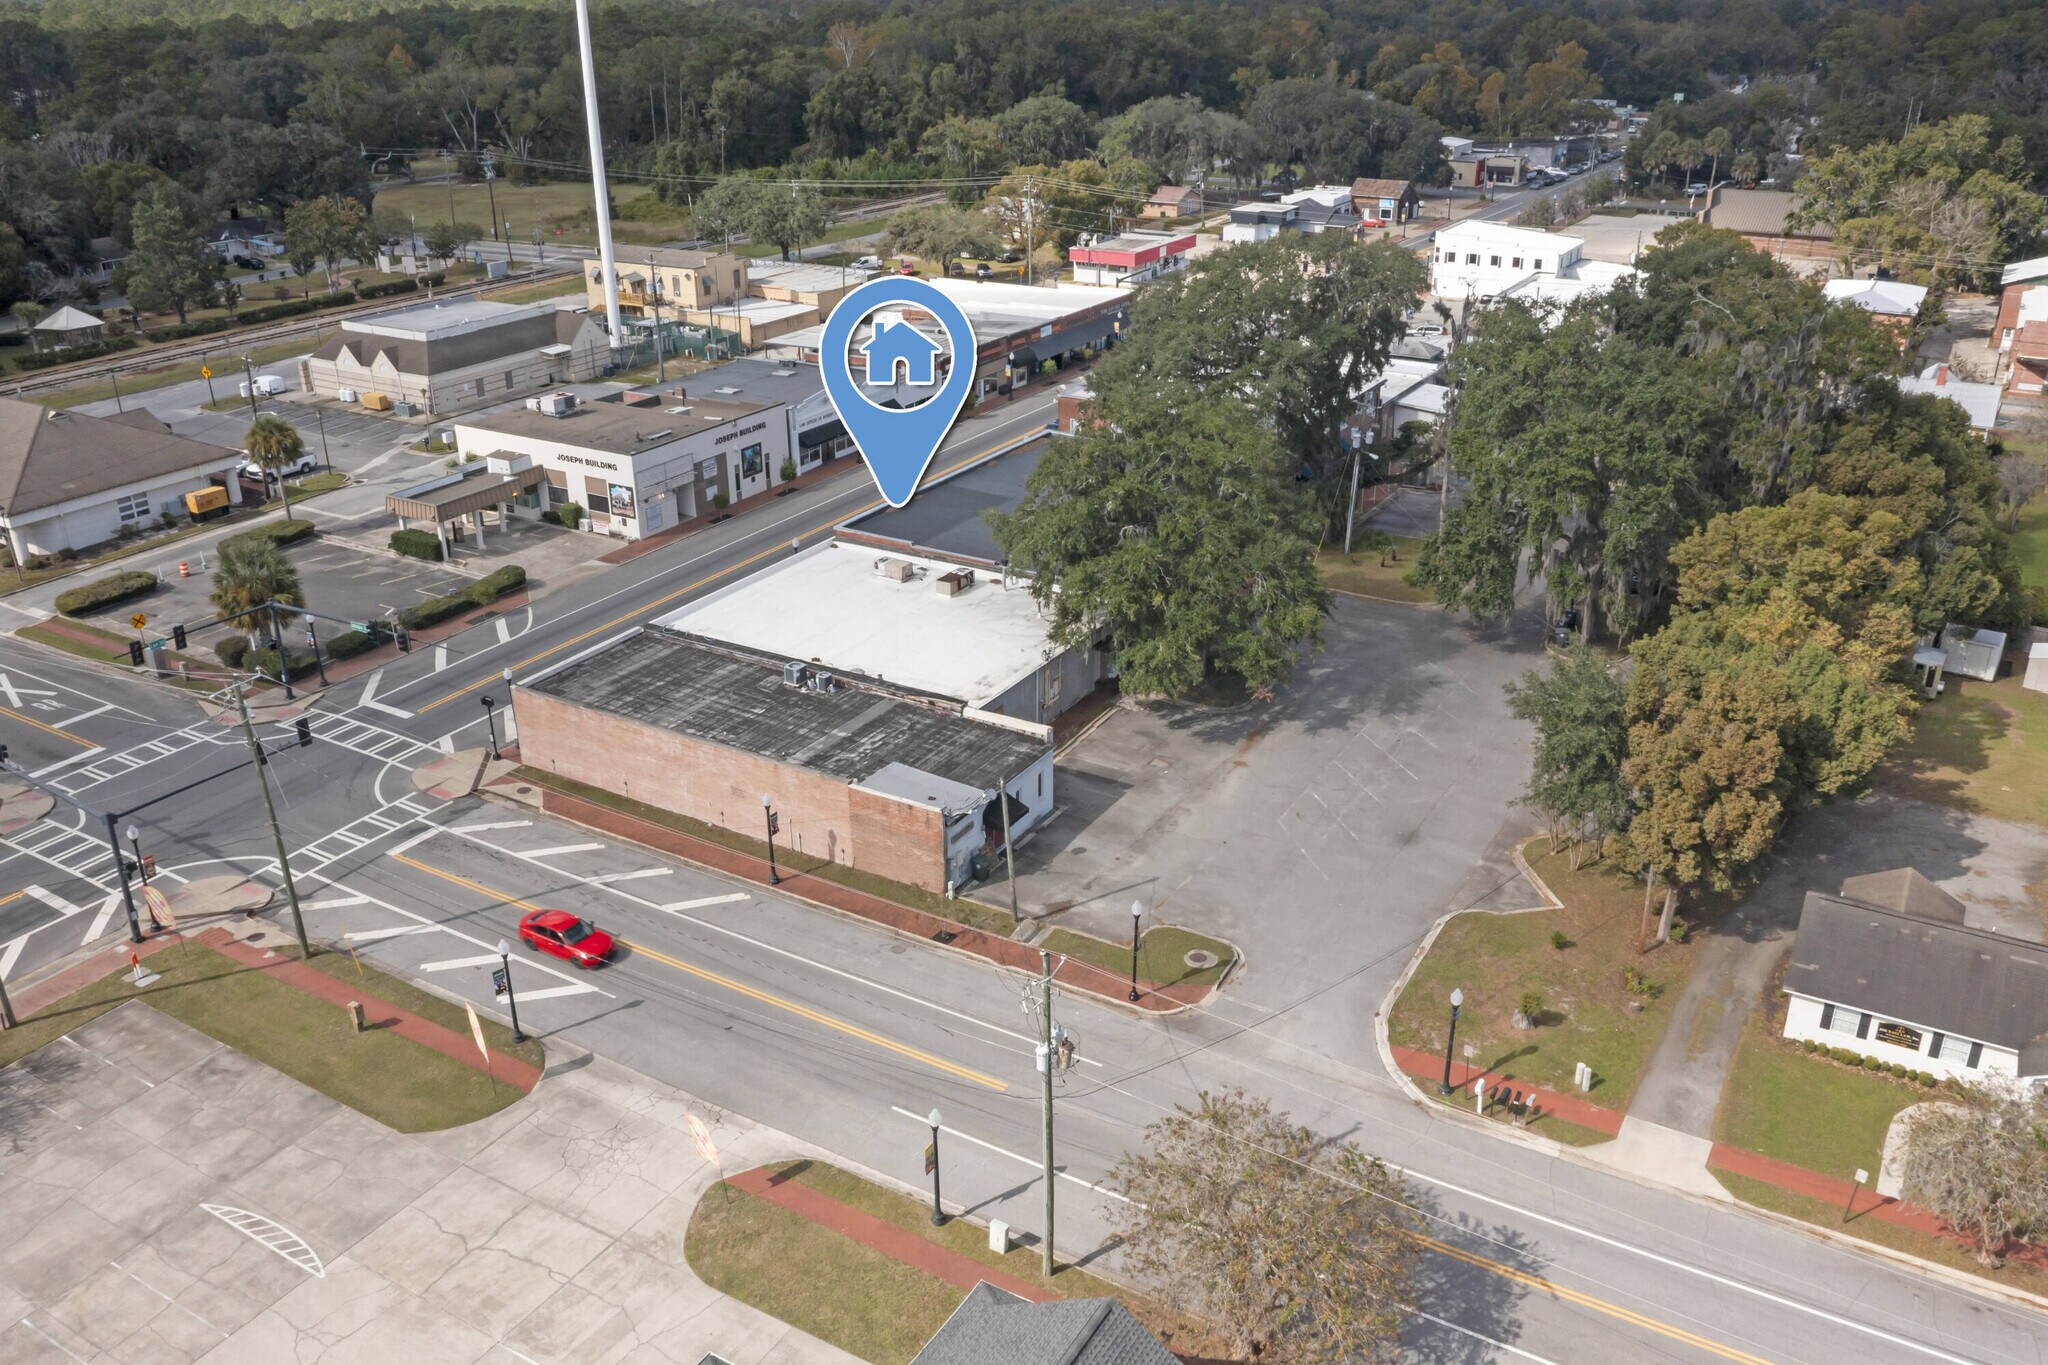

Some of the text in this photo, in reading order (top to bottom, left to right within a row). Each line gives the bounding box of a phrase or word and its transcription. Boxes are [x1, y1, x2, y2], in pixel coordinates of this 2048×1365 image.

[715, 421, 766, 445] JOSEPH BUILDING
[557, 454, 618, 471] JOSEPH BUILDING
